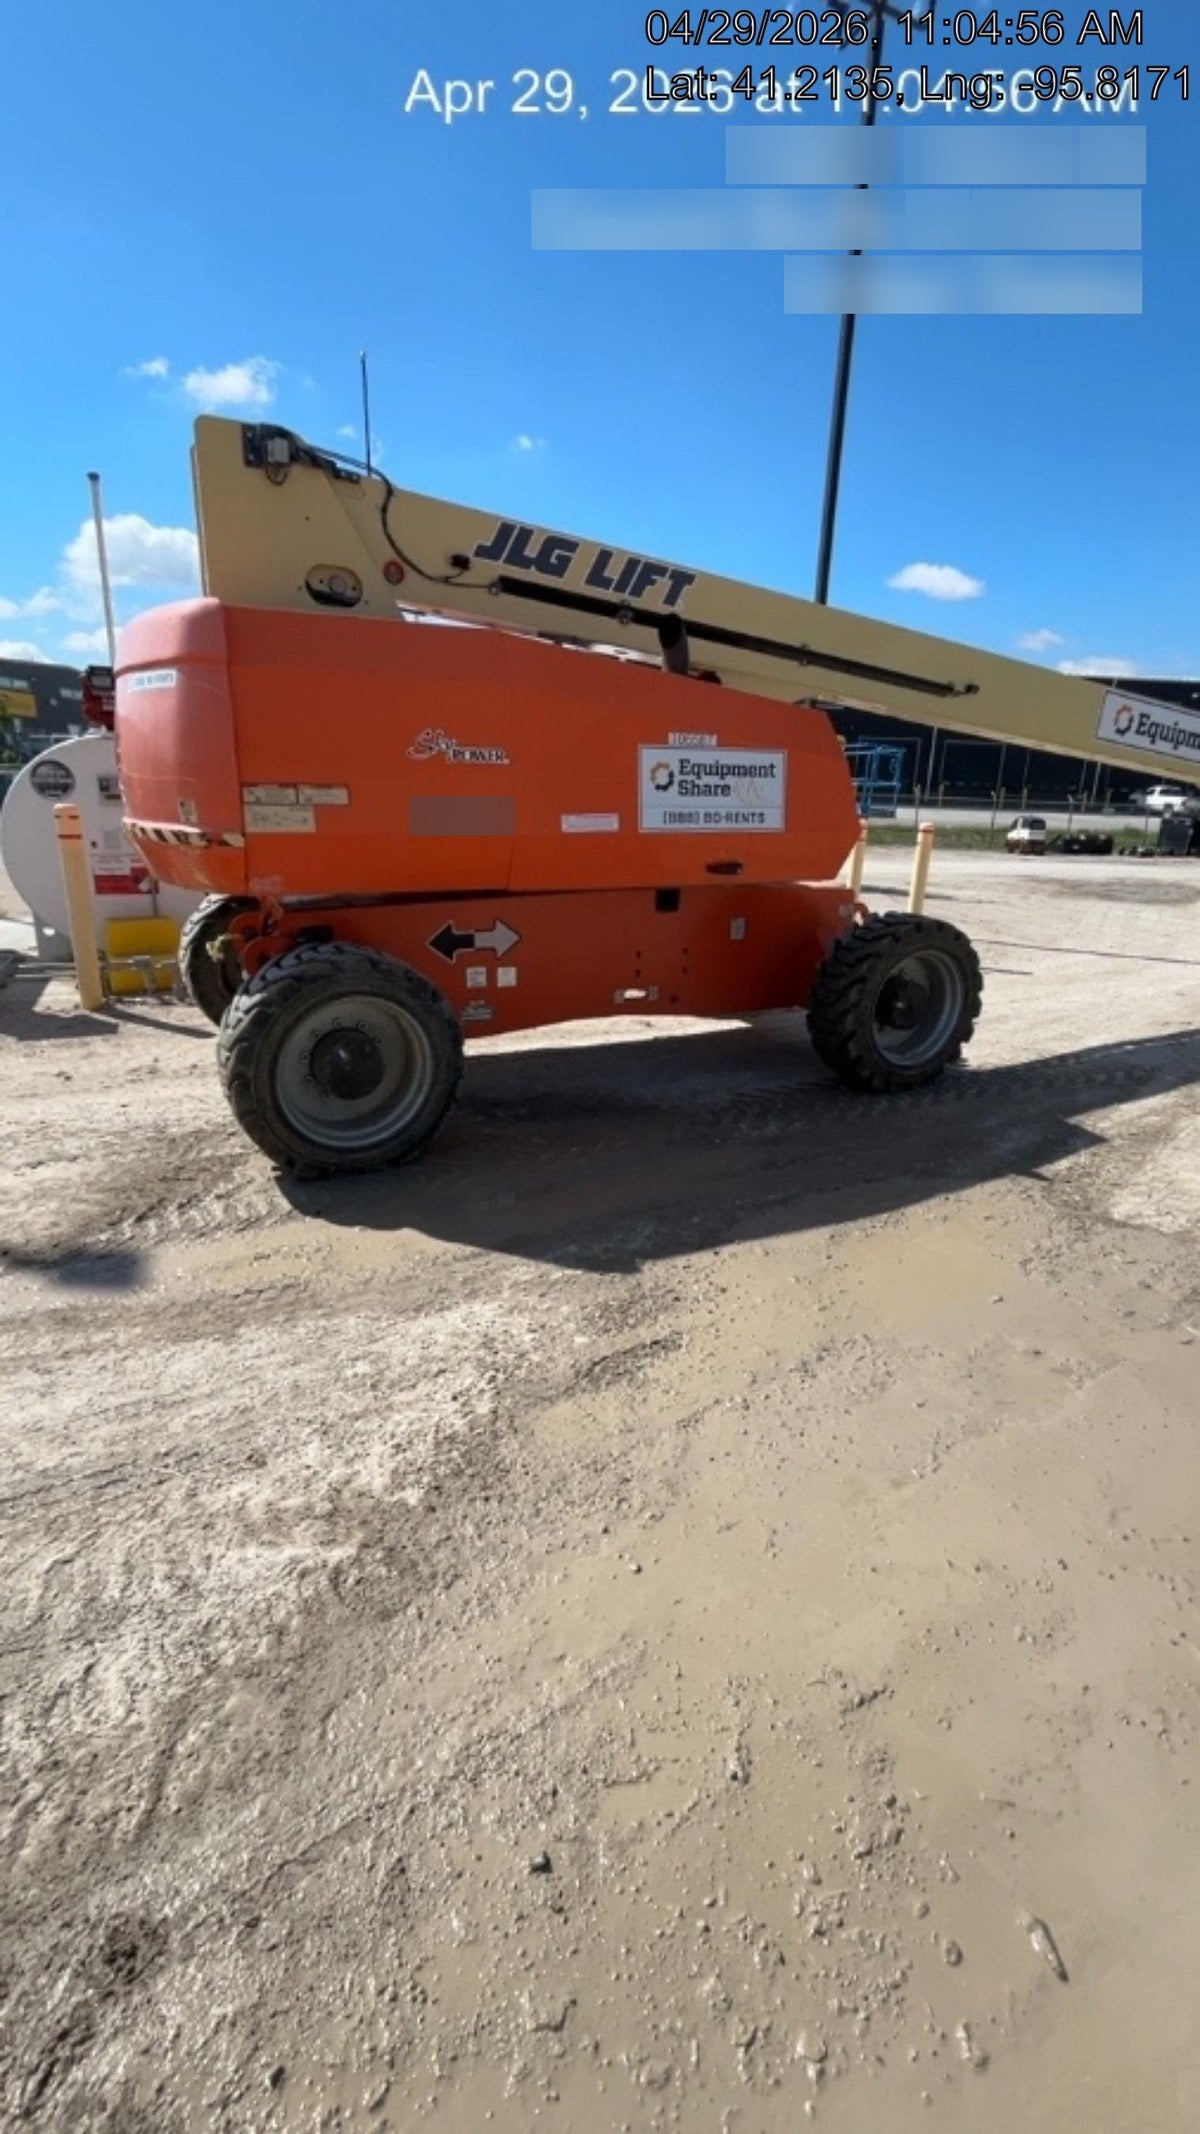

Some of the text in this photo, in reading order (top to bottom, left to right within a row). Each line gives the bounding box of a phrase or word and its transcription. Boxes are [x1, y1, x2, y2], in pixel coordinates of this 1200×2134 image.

[474, 521, 697, 607] JLG LIFT
[678, 758, 776, 780] Equipment
[678, 779, 731, 797] Share
